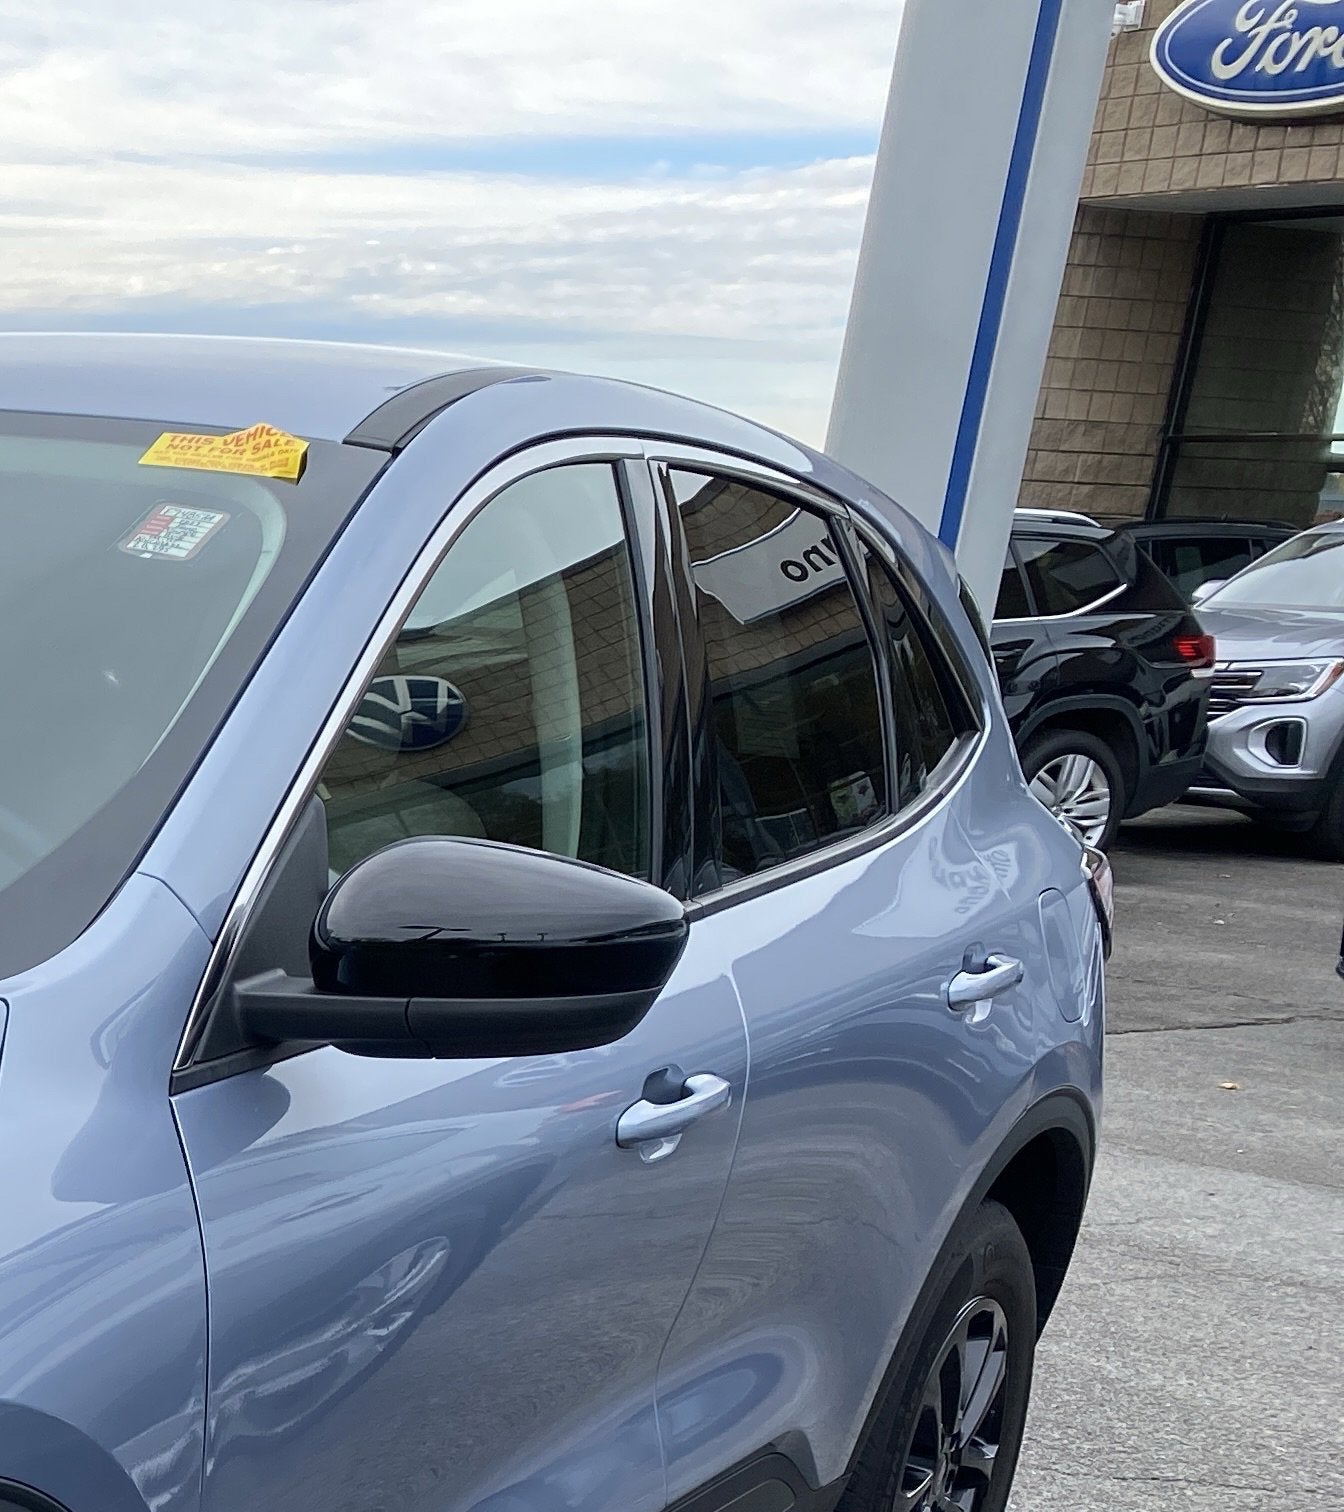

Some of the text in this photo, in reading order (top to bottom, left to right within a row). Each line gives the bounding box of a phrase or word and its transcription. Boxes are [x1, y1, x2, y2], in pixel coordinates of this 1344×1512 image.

[1211, 0, 1344, 80] For
[165, 443, 202, 452] NOT
[207, 446, 247, 456] FOR
[251, 438, 297, 455] SALE
[169, 425, 280, 448] THIS VEHIC
